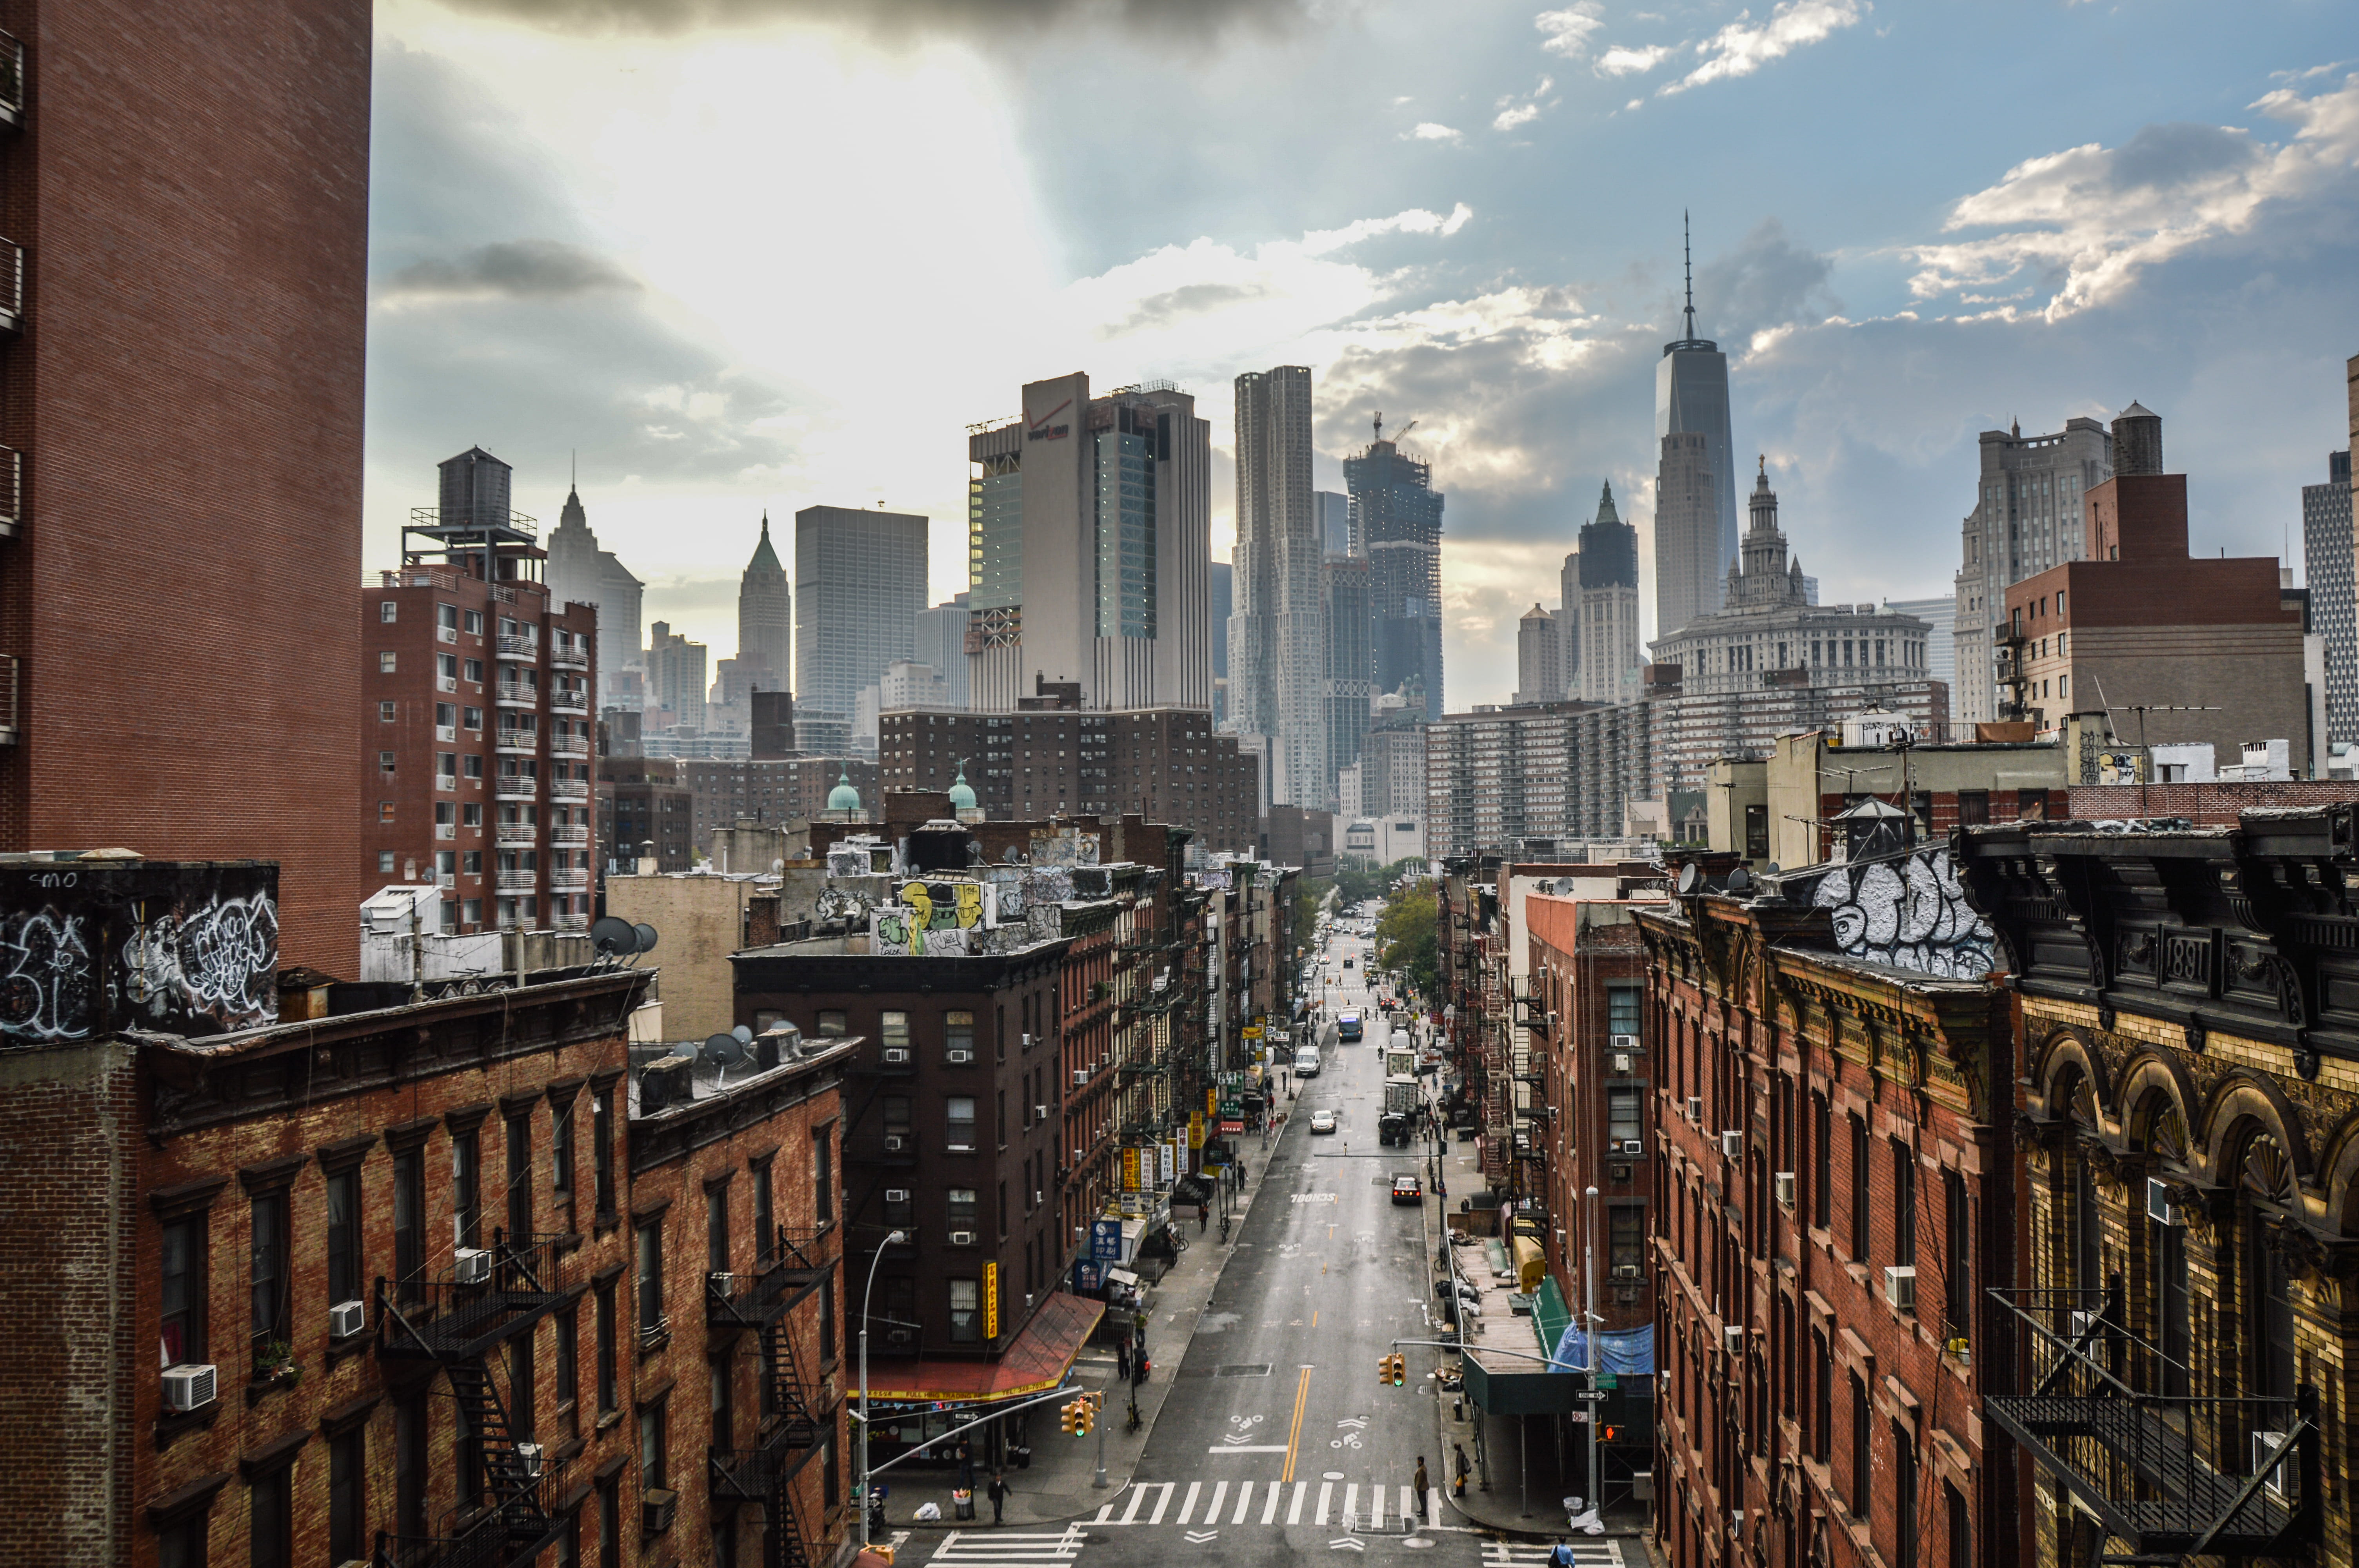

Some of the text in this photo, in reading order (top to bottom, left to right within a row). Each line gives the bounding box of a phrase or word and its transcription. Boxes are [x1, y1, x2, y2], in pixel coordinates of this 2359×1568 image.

[1028, 425, 1069, 441] verizon
[2167, 938, 2203, 981] 1891
[1290, 1193, 1336, 1203] SCHOOL
